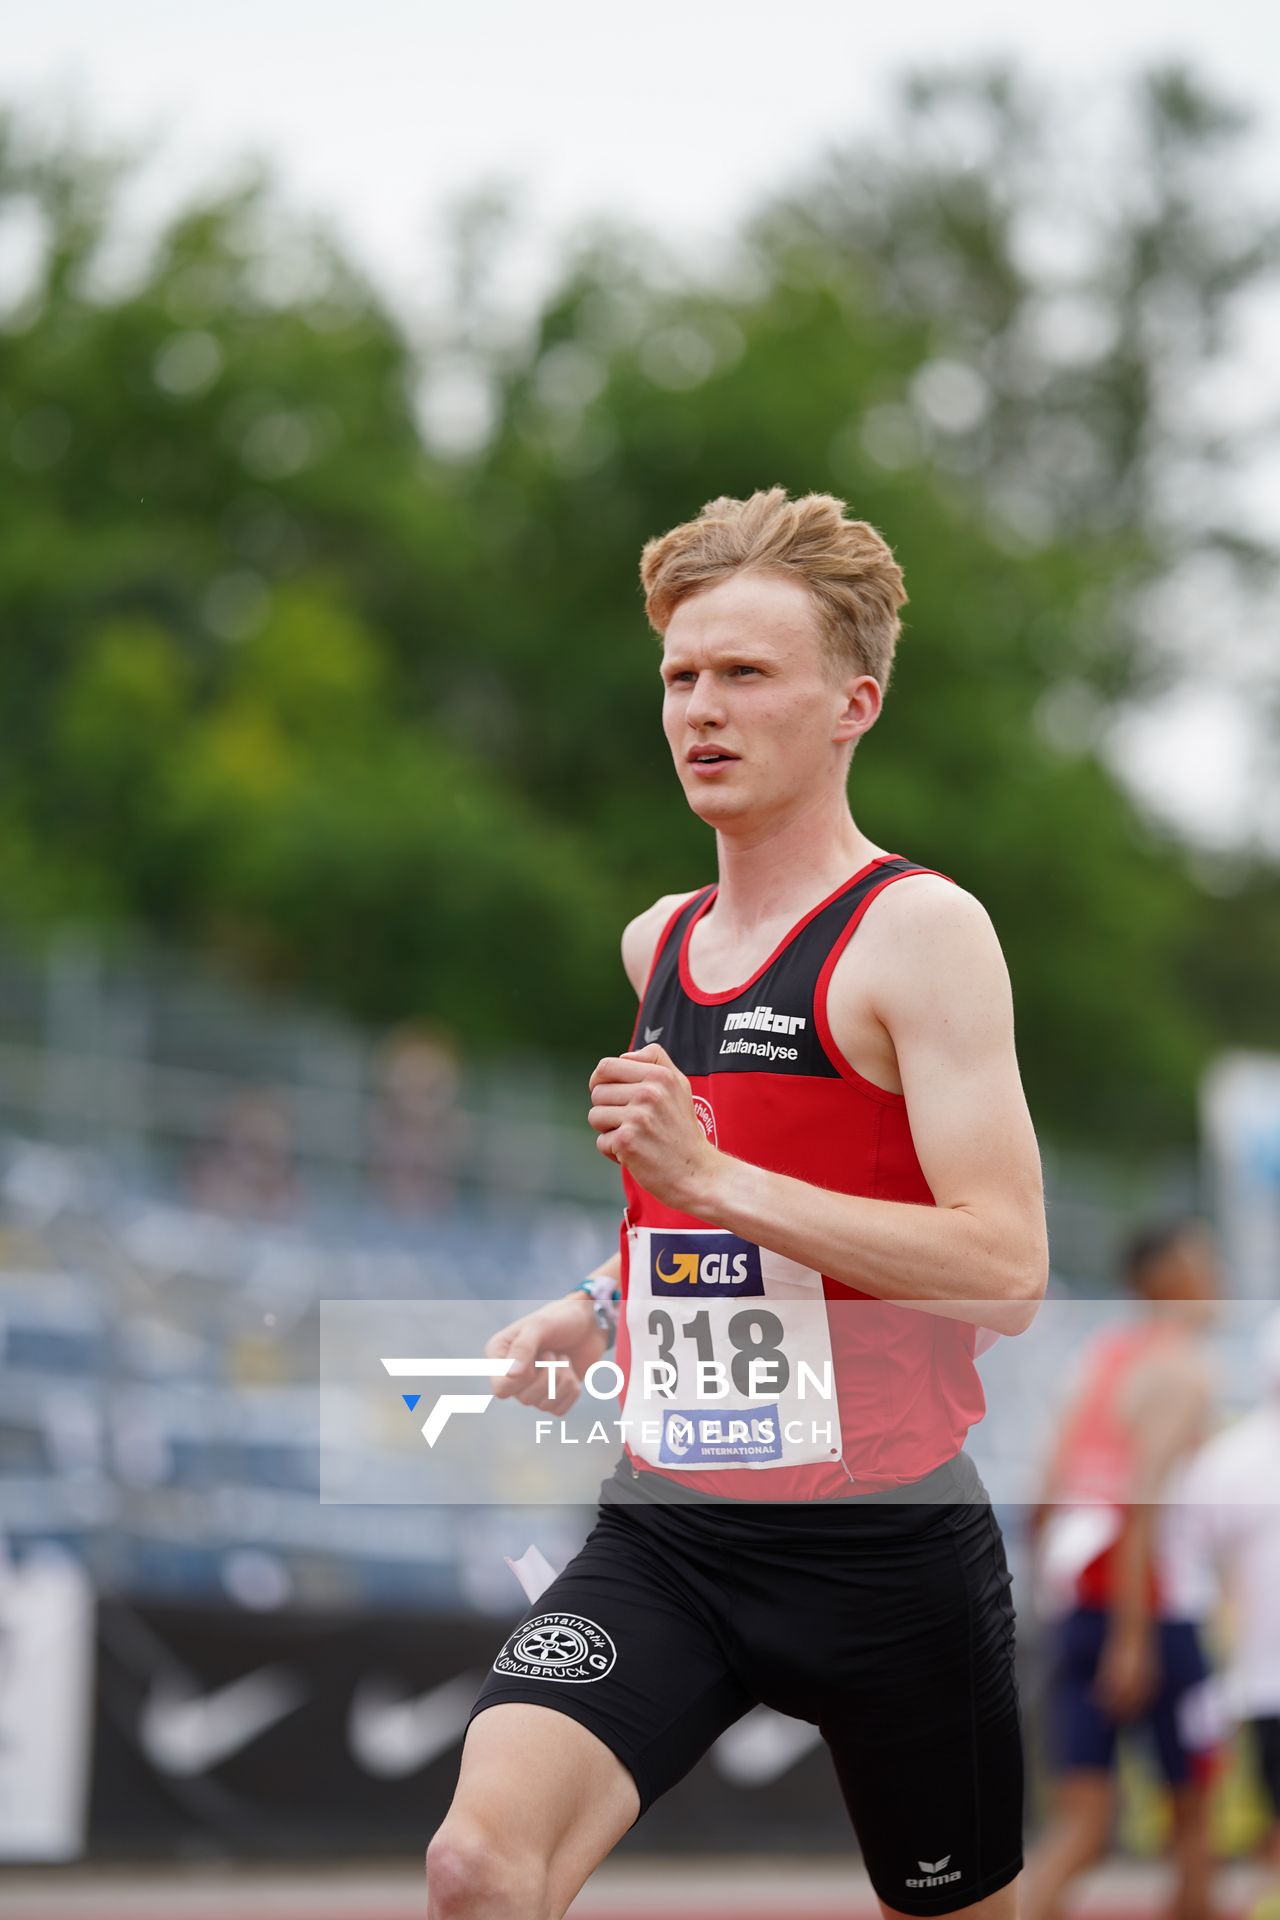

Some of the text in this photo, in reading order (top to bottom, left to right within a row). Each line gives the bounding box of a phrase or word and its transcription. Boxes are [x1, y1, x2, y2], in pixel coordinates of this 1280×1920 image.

[724, 1006, 806, 1035] molitor
[719, 1038, 798, 1060] Laufanalyse
[694, 1103, 714, 1135] thletik
[700, 1253, 748, 1284] GLS
[648, 1309, 790, 1399] 318
[701, 1446, 775, 1456] INTERNATIONAL
[513, 1616, 606, 1648] Leichtathletik
[905, 1870, 962, 1888] erima
